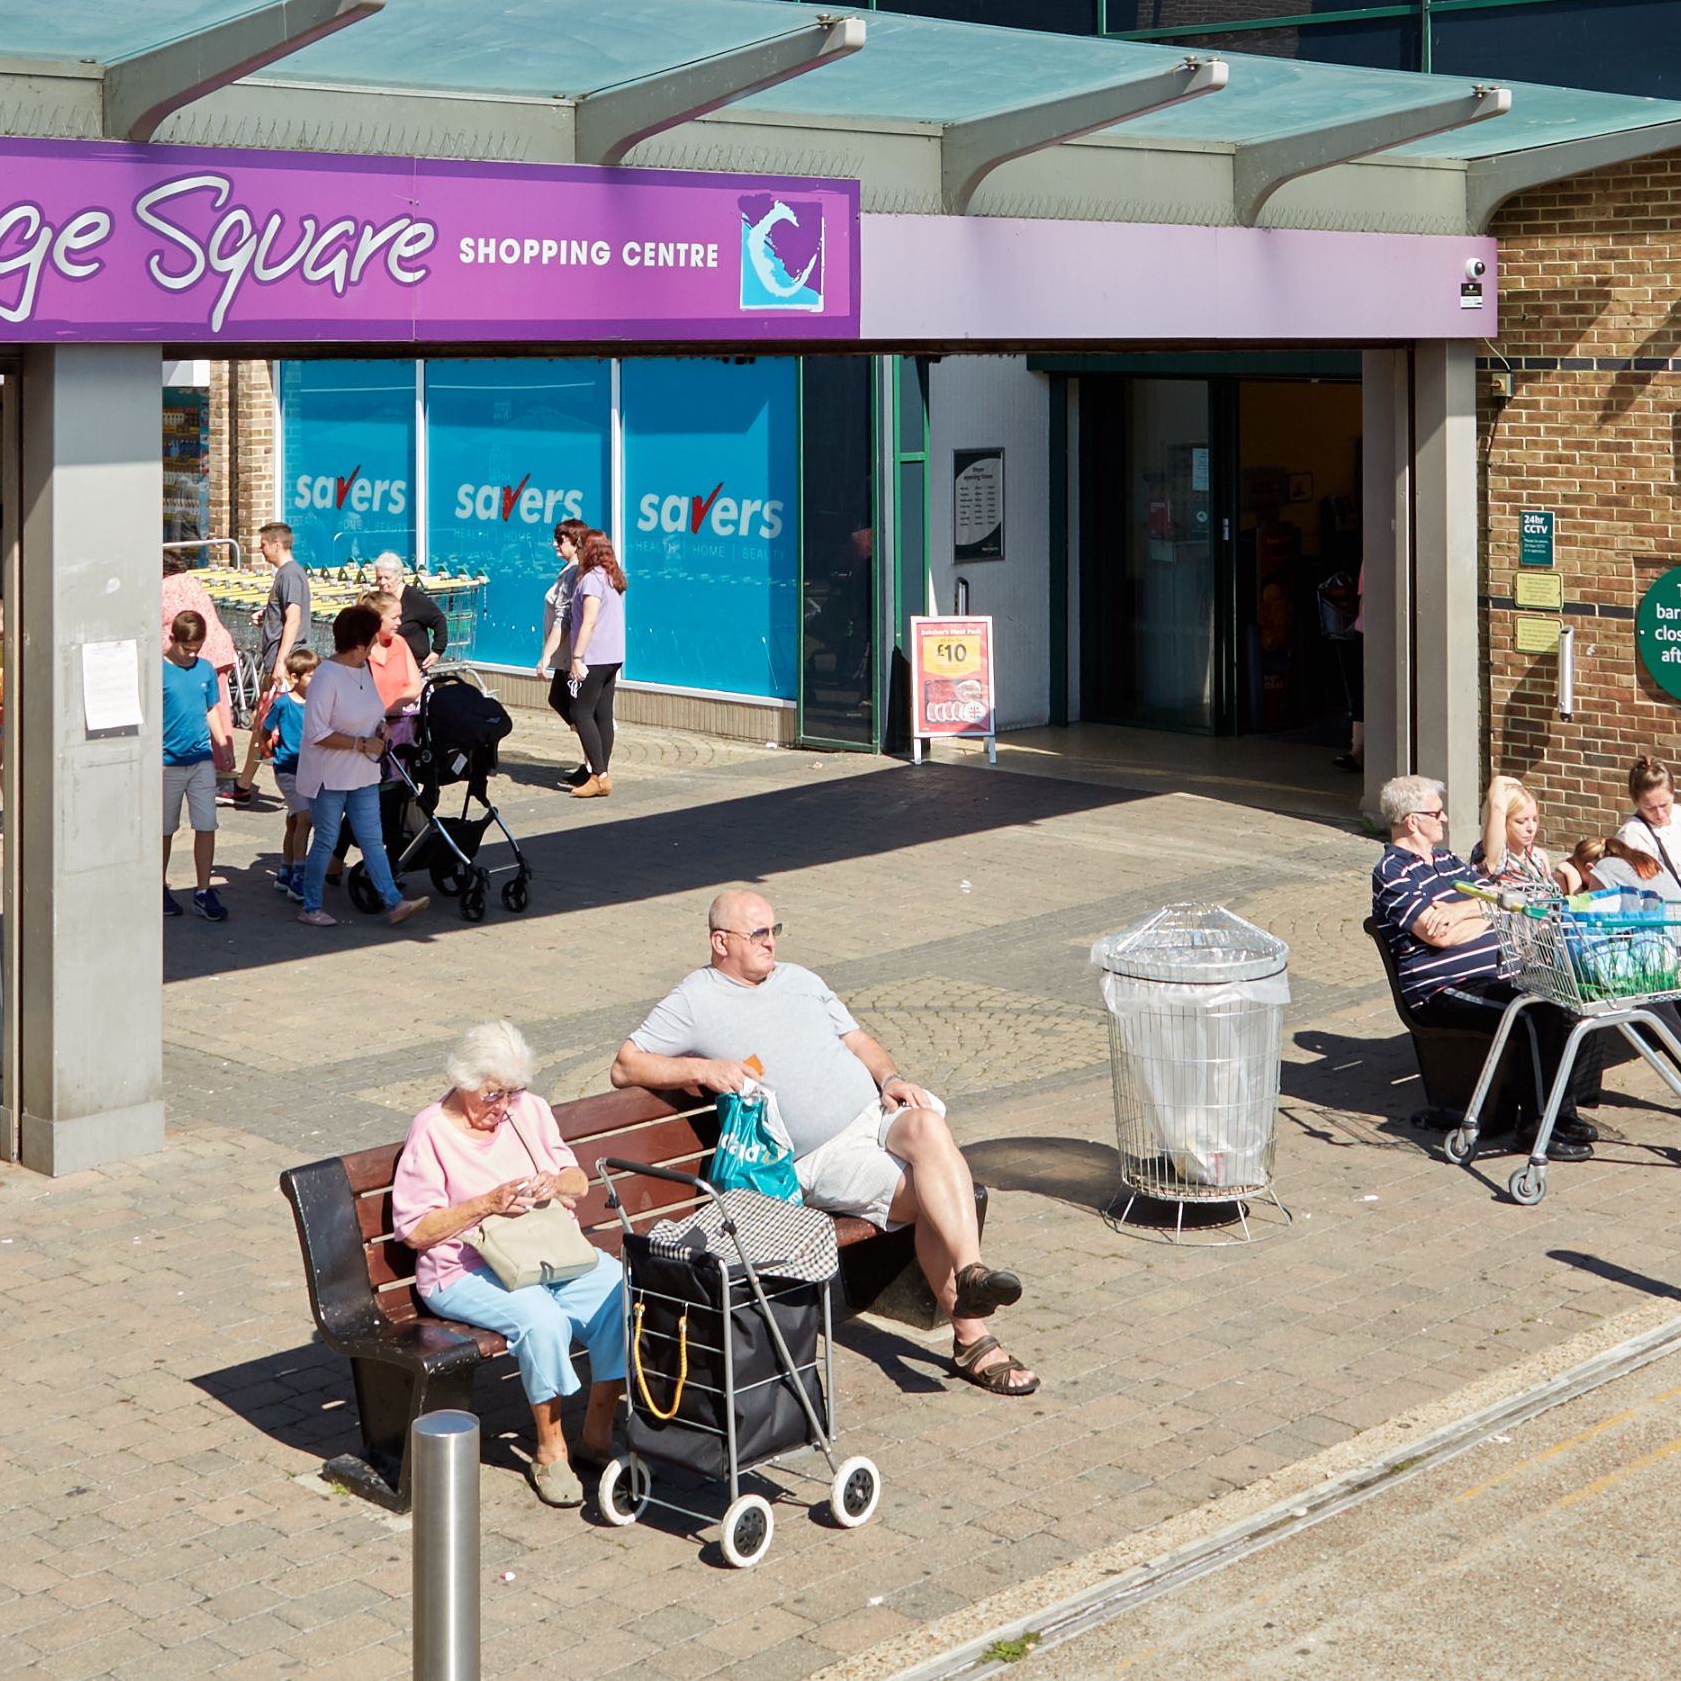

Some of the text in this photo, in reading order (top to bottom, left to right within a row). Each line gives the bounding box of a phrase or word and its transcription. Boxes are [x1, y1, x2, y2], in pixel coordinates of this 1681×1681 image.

[135, 174, 436, 333] Square
[458, 236, 612, 267] SHOPPING
[621, 240, 719, 268] CENTRE
[294, 464, 406, 515] savers
[454, 473, 585, 524] savers
[637, 481, 784, 540] savers
[1523, 514, 1545, 525] 24hr
[1523, 524, 1548, 535] CCTV
[692, 544, 725, 558] HOME
[742, 546, 786, 561] BEAUTY
[937, 643, 967, 663] £10
